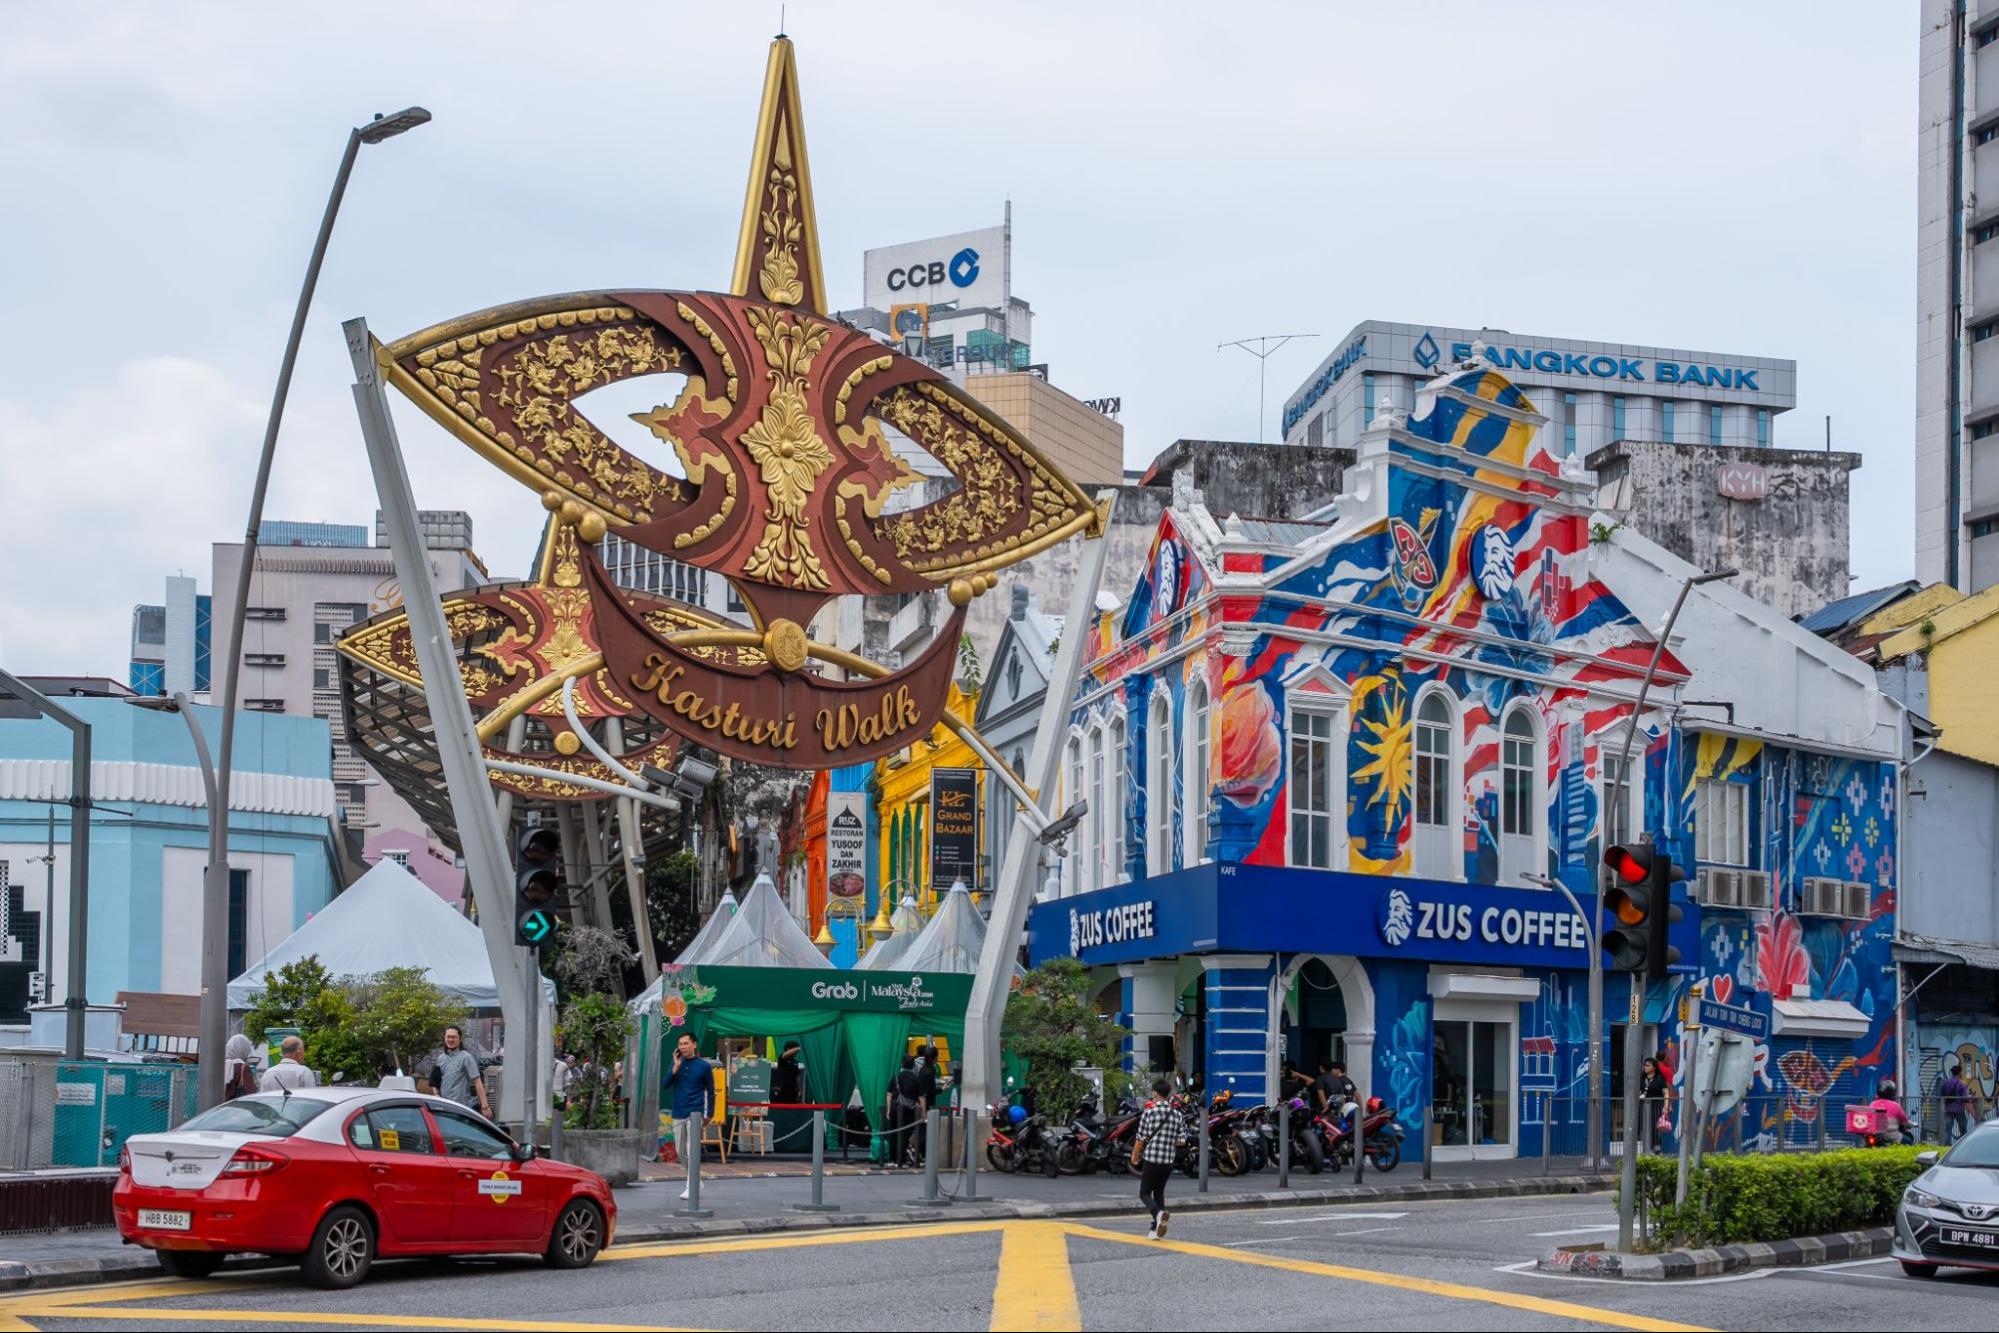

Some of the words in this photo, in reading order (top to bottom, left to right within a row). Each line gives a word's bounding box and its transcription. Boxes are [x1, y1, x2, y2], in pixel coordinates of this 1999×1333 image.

[887, 262, 945, 291] CCB
[1452, 343, 1645, 380] BANGKOK
[1655, 362, 1760, 391] BANK
[631, 653, 799, 748] Kasturi
[816, 684, 921, 751] Walk
[937, 810, 972, 820] GRAND
[830, 829, 863, 837] RESTORAN
[935, 823, 973, 834] BAZAAR
[831, 840, 863, 849] YUSOOF
[840, 850, 854, 858] DAN
[831, 860, 862, 869] ZAKHIR
[1220, 866, 1237, 876] KAFE
[1079, 910, 1102, 947] ZUS
[1105, 901, 1154, 943] COFFEE
[1417, 902, 1472, 941] ZUS
[1481, 907, 1586, 948] COFFEE
[811, 981, 858, 1000] Grab
[871, 985, 921, 1000] Malaysia
[1704, 1005, 1718, 1019] JALAN
[145, 1213, 161, 1225] HBB
[163, 1214, 184, 1227] 5882
[1951, 1230, 1970, 1242] BPW
[1972, 1233, 1995, 1245] 4881
